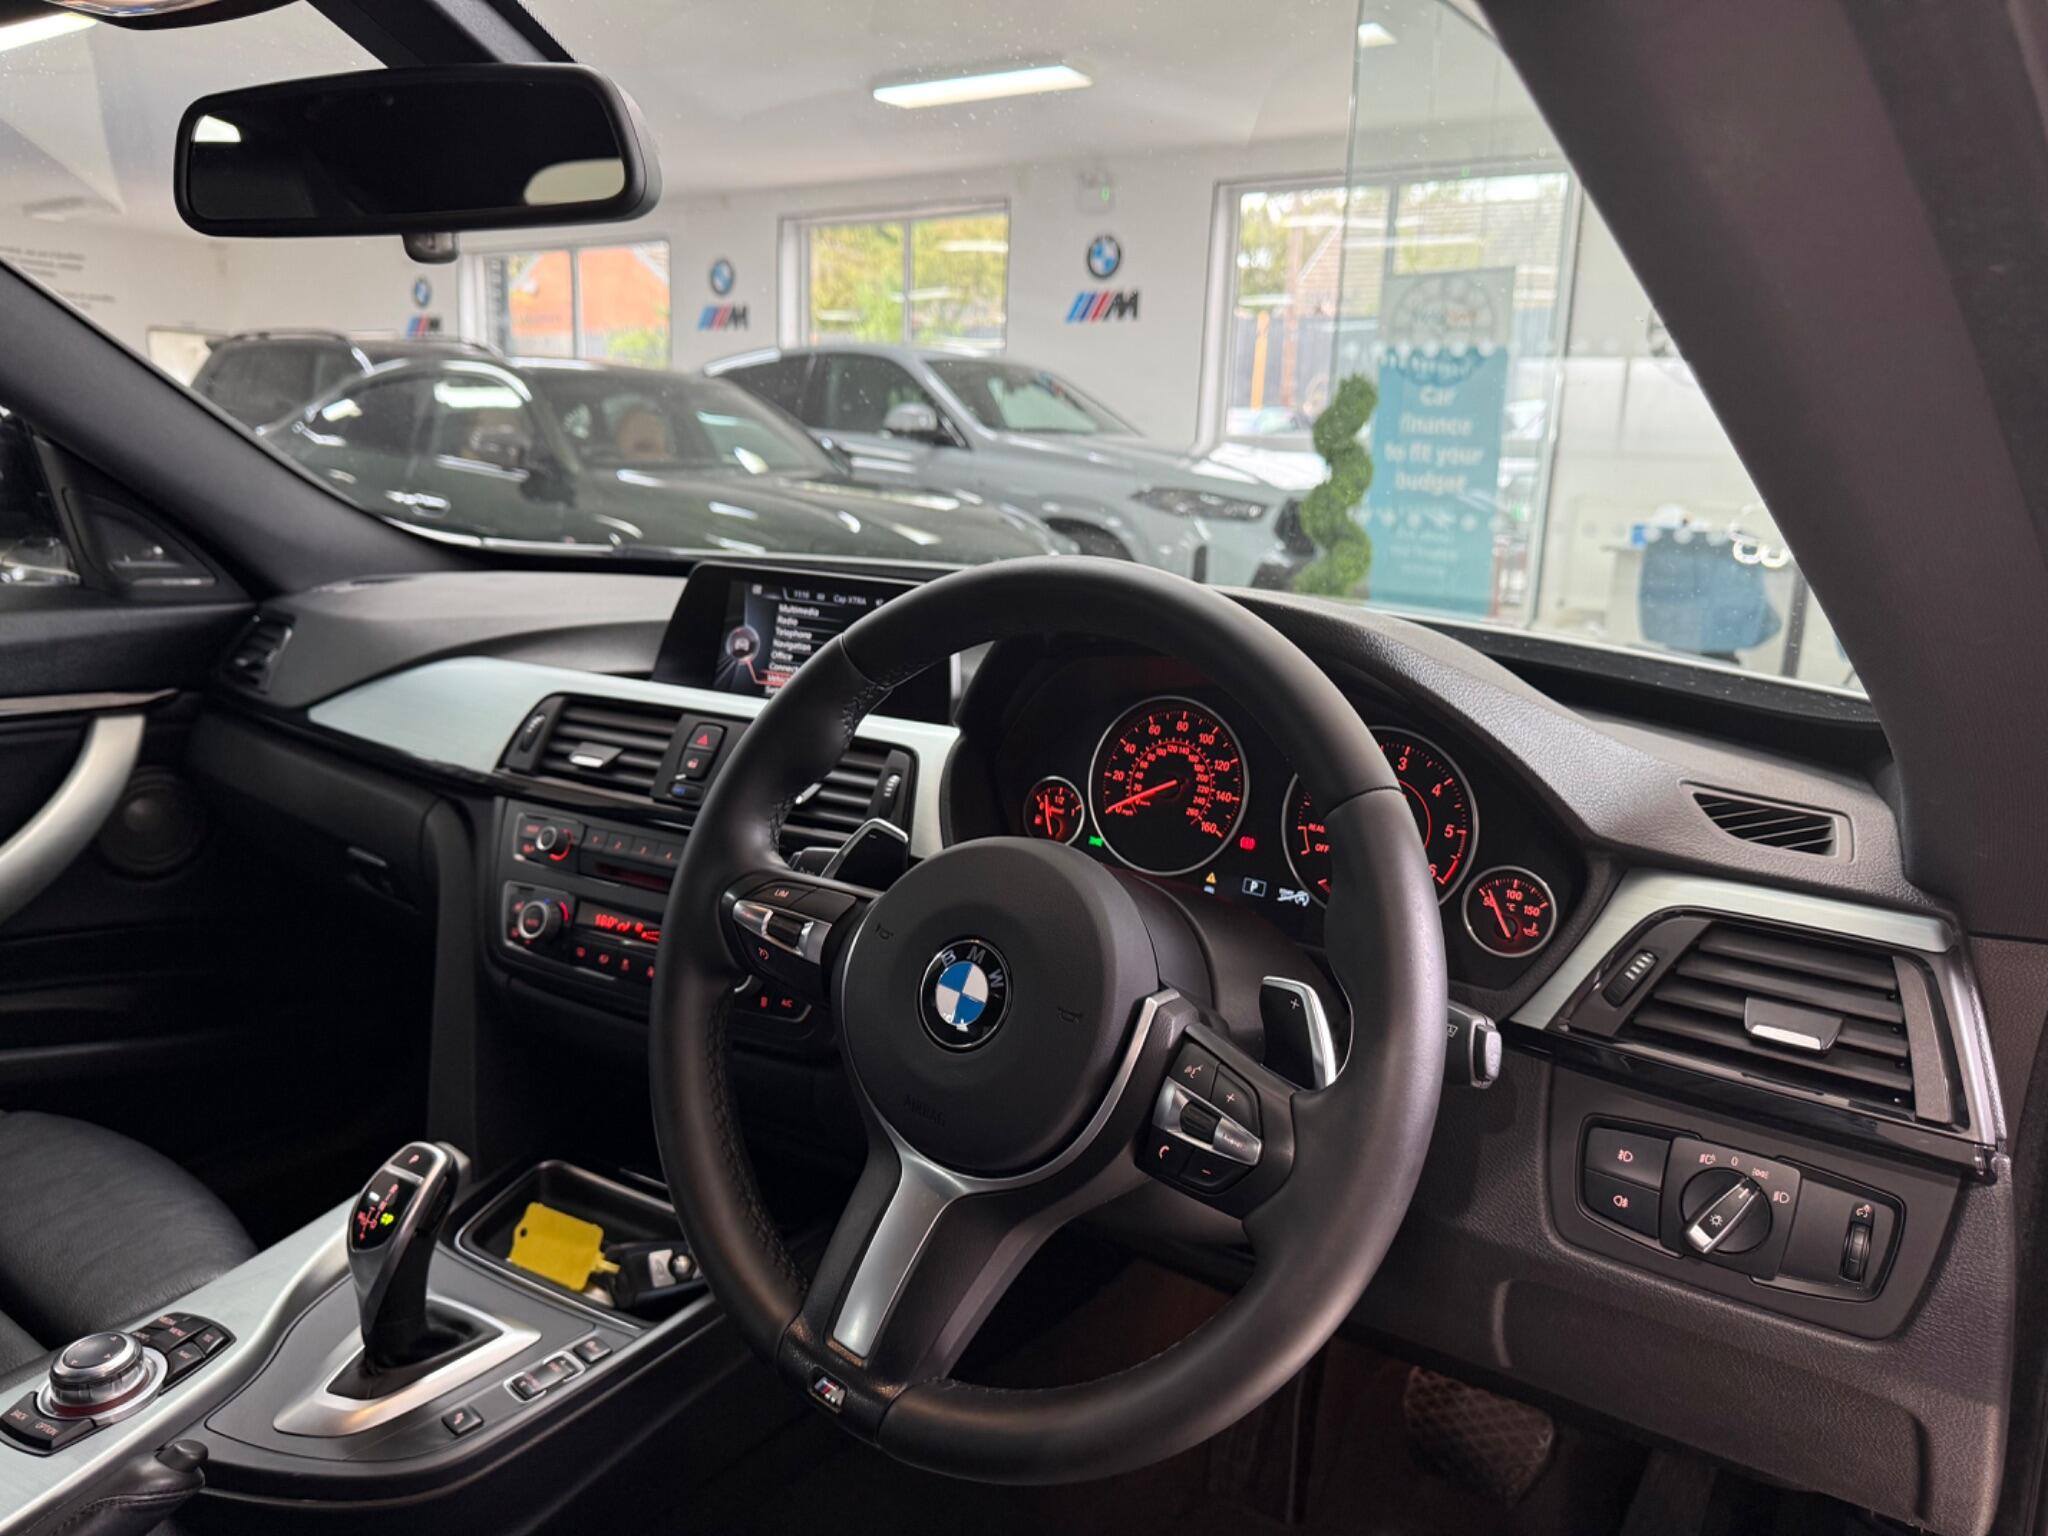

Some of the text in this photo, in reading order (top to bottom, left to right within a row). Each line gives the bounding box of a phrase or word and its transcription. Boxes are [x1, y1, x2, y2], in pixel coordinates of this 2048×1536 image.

[1420, 385, 1455, 406] Car
[1401, 411, 1473, 435] finance
[1384, 442, 1484, 468] to fit your
[1395, 473, 1467, 497] budget
[778, 603, 820, 617] Multimedia
[777, 615, 799, 627] Radio
[775, 626, 813, 639] Telephone
[772, 638, 812, 652] Navigation
[770, 650, 794, 661] Office
[1148, 725, 1161, 736] 60
[1176, 721, 1190, 732] 80
[1199, 734, 1215, 746] 100
[1124, 743, 1137, 755] 40
[1214, 760, 1230, 772] 120
[1397, 757, 1408, 772] 3
[1112, 769, 1125, 782] 20
[1216, 790, 1233, 803] 140
[1431, 783, 1442, 798] 4
[1201, 821, 1217, 834] 160
[1443, 824, 1455, 838] 5
[774, 887, 790, 898] LIM
[1250, 880, 1258, 892] P
[1506, 889, 1523, 901] 100
[1523, 905, 1540, 917] 150
[940, 945, 1005, 988] BMW
[34, 1421, 59, 1437] OPTION
